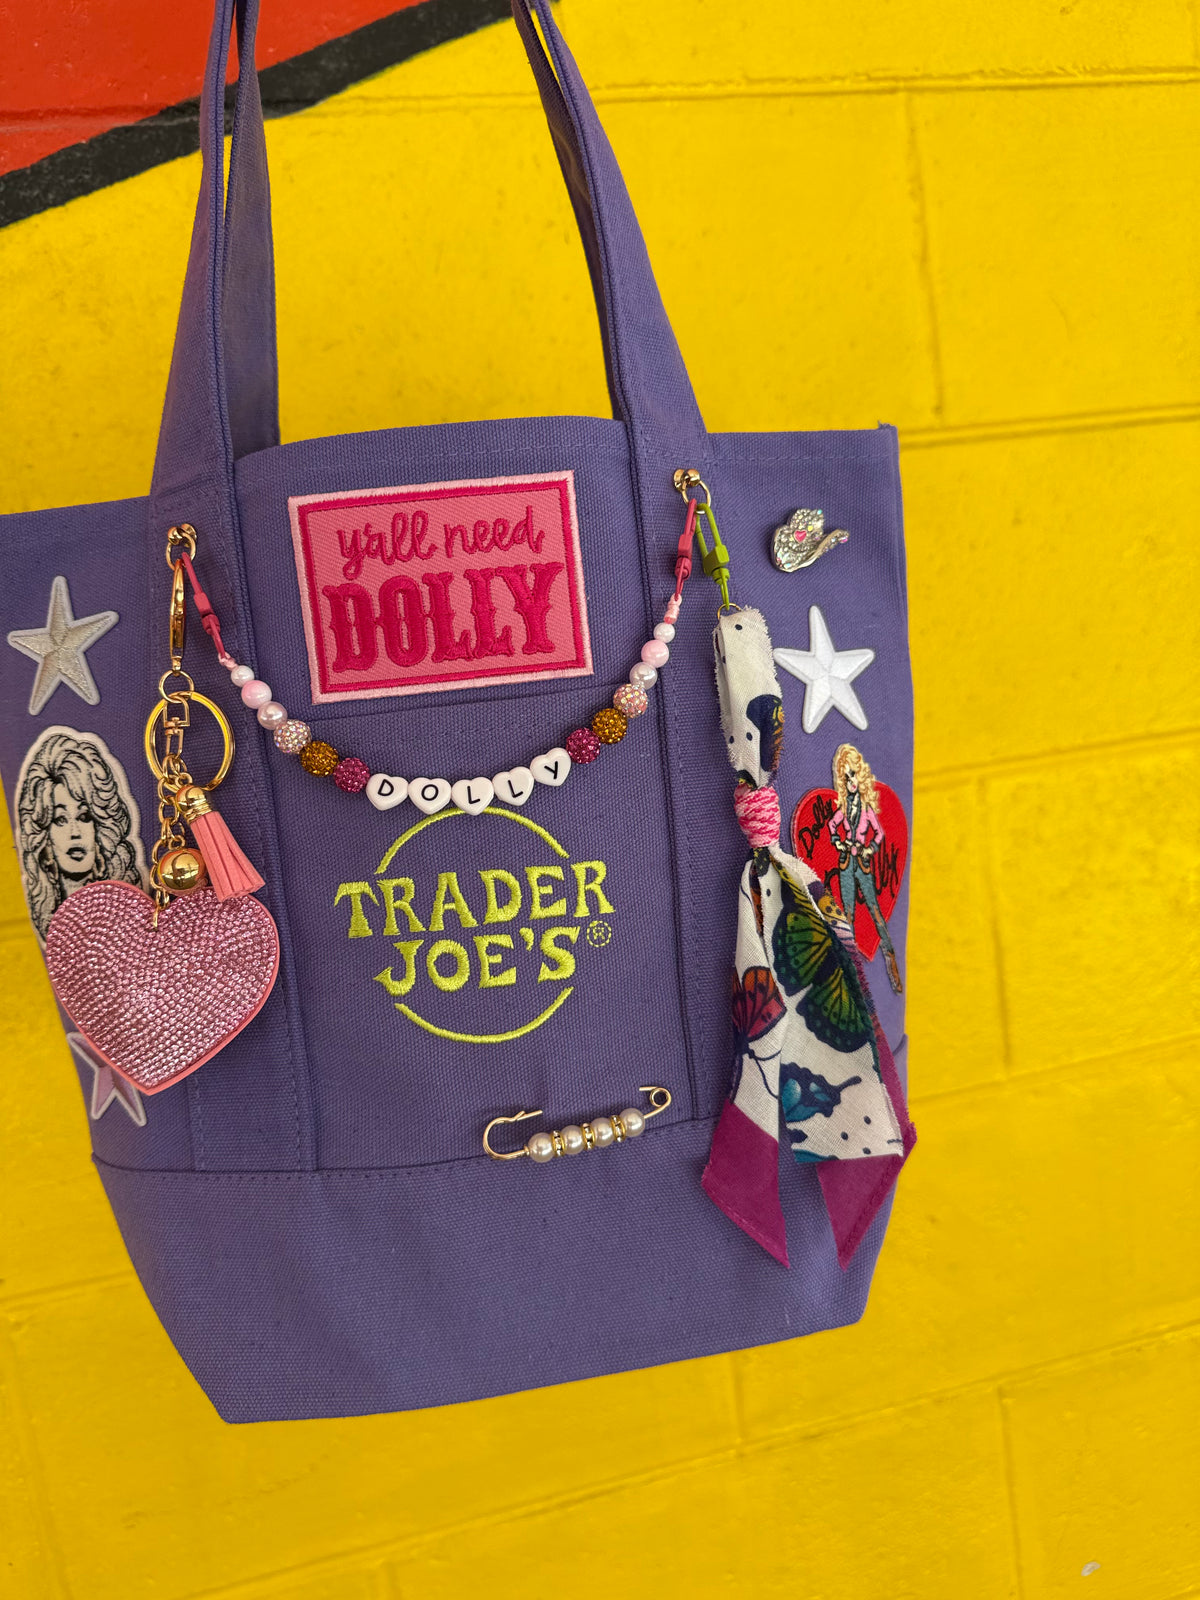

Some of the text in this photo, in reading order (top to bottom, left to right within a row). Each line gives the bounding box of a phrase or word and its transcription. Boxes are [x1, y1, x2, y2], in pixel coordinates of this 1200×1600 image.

[336, 505, 546, 581] y'all need
[321, 561, 564, 673] DOLLY
[376, 760, 560, 805] DOLLY
[799, 795, 833, 860] Dolly
[333, 860, 616, 938] TRADER
[372, 926, 581, 997] JOE'S
